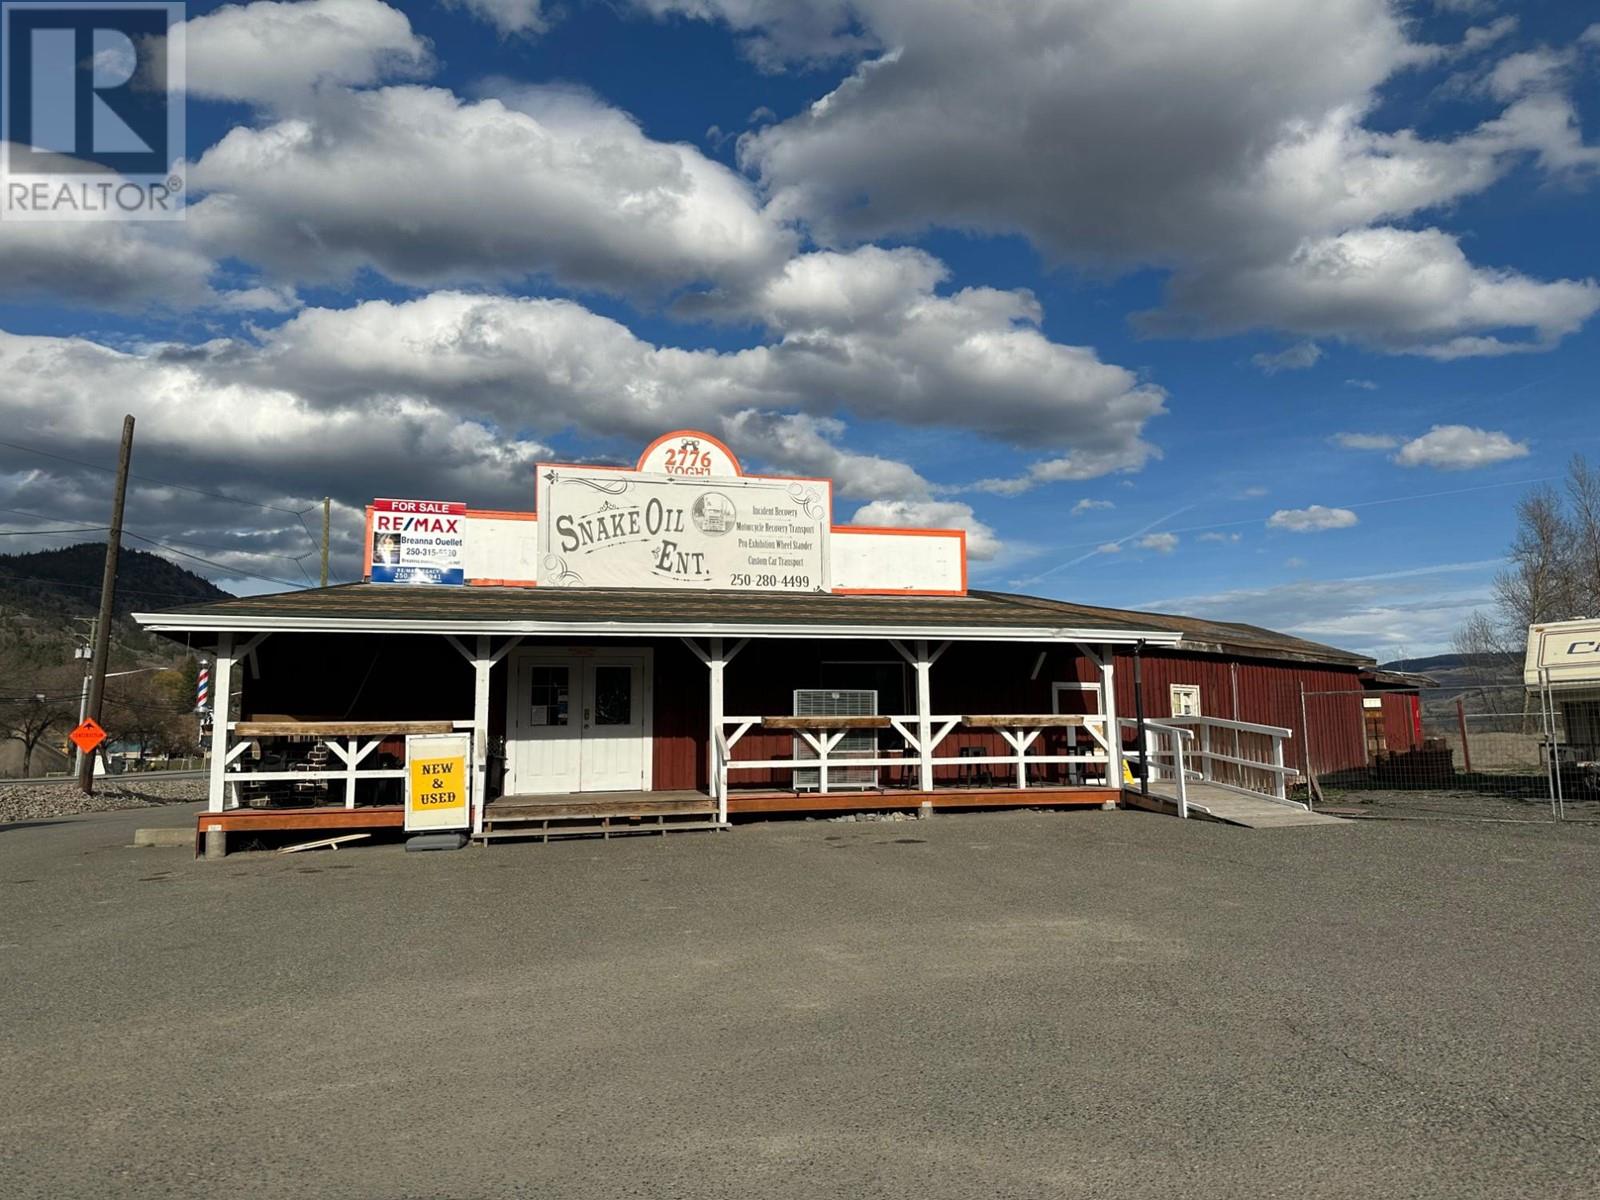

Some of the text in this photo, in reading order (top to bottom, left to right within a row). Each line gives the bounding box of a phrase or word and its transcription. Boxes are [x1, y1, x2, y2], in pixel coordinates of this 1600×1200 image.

[665, 448, 712, 467] 2776
[392, 502, 449, 513] FOR SALE
[752, 505, 797, 518] Incident Recovery
[378, 516, 458, 534] RE/MAX
[556, 497, 685, 553] SNAKE OIL
[736, 522, 814, 535] Motorcycle Recovery Transport
[401, 536, 463, 547] Breanna Ouellet
[738, 538, 813, 550] Pro Exhibition Wheel Stander
[655, 539, 710, 576] ENT.
[748, 555, 767, 565] Custom
[778, 556, 804, 567] Transport
[730, 573, 810, 588] 250-280-4499
[422, 762, 454, 775] NEW
[432, 778, 444, 789] &
[421, 791, 456, 805] USED
